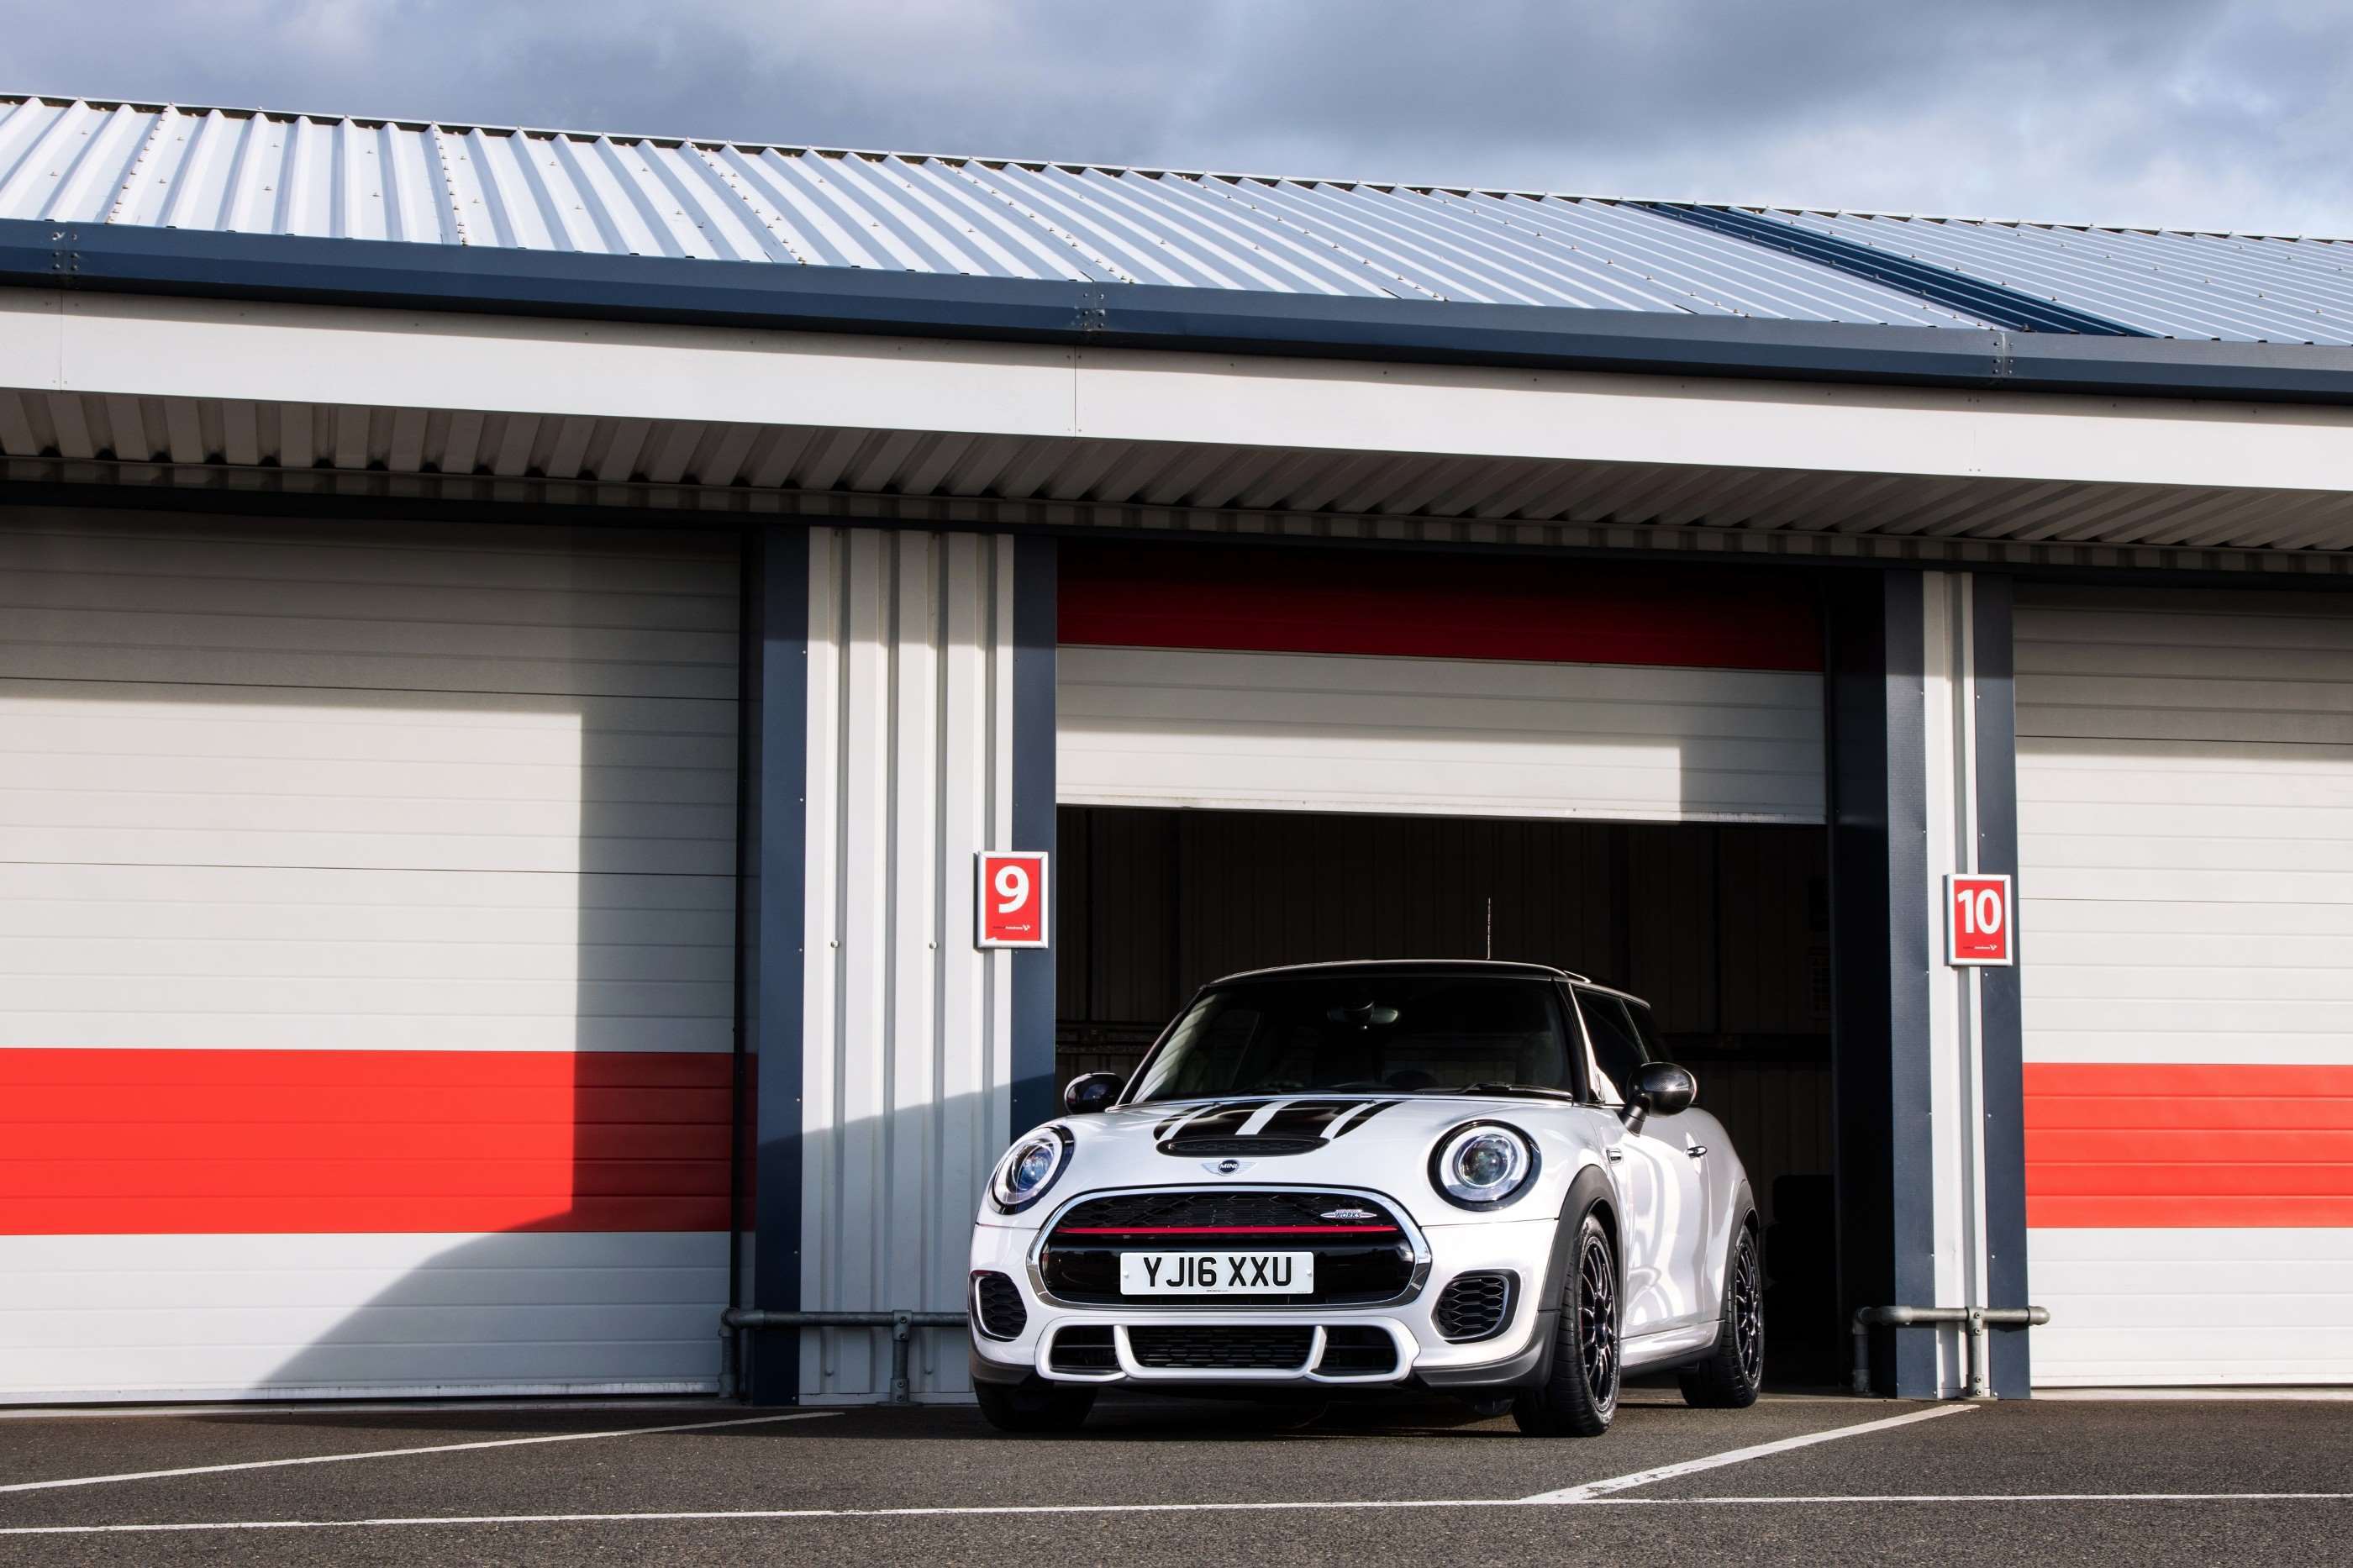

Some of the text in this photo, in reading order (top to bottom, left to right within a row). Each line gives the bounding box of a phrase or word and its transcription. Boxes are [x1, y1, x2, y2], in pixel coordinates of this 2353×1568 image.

[995, 866, 1029, 913] 9
[1957, 888, 2002, 934] 10
[1143, 1256, 1292, 1286] YJ16 XXU
